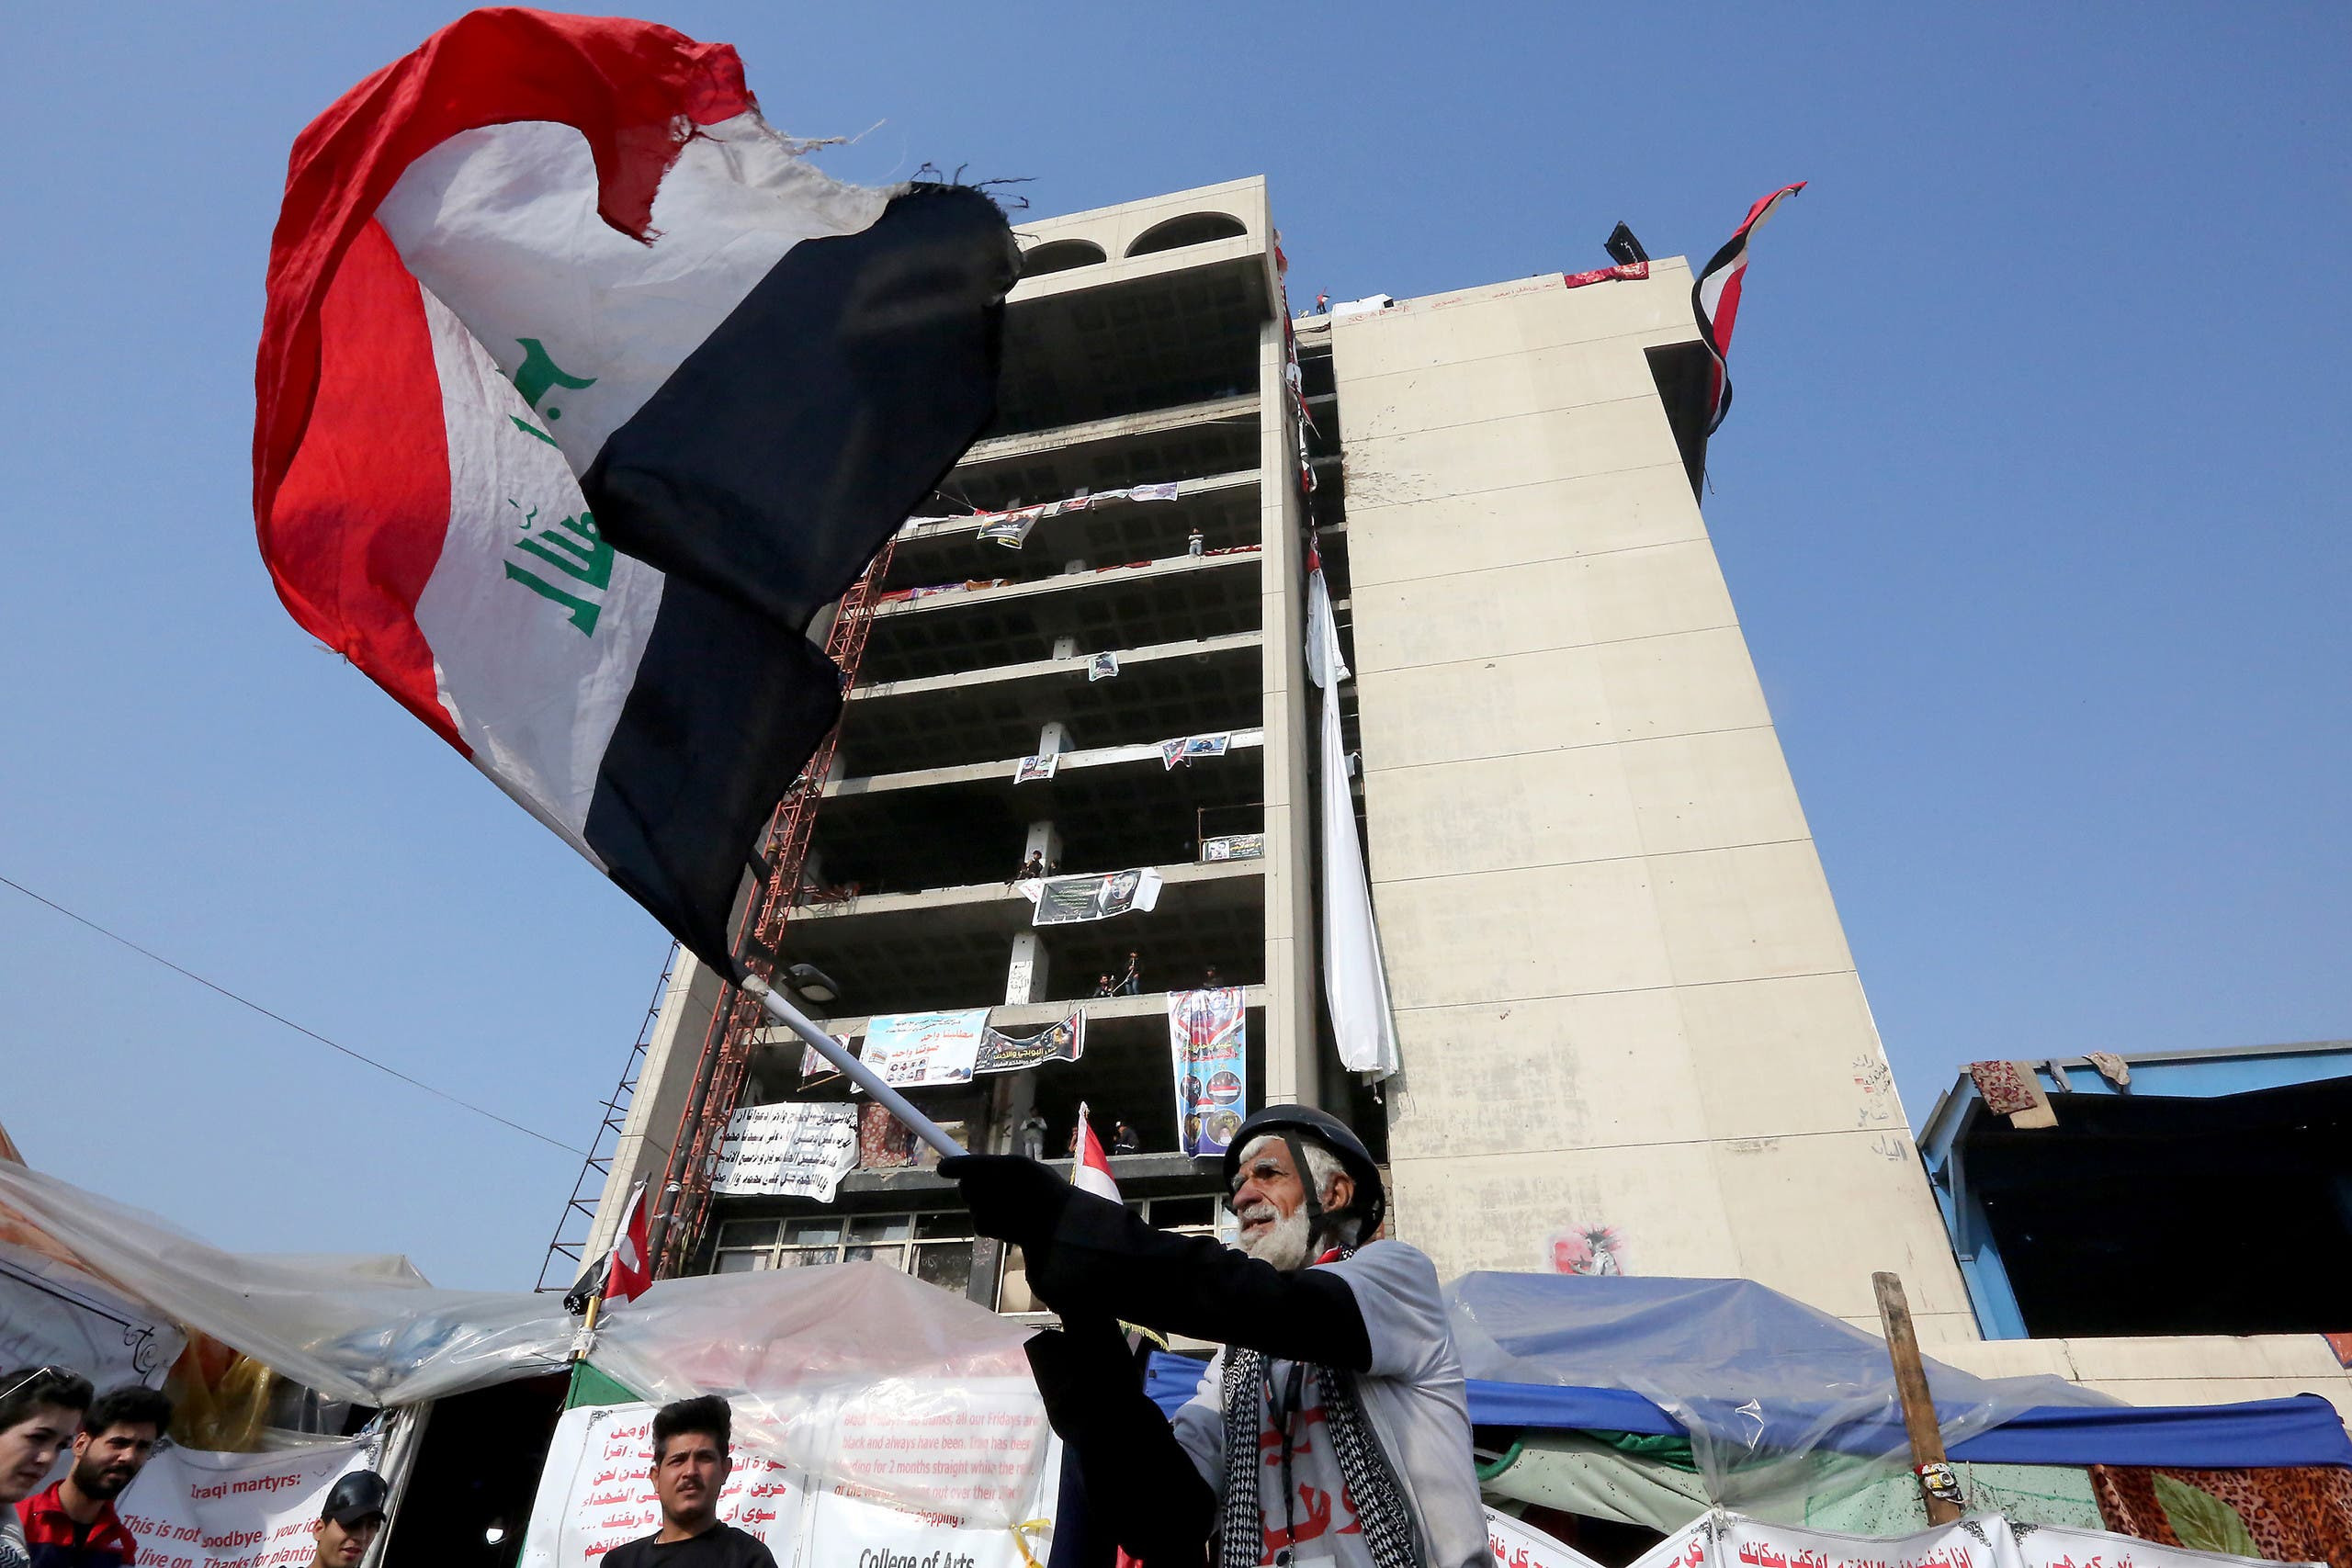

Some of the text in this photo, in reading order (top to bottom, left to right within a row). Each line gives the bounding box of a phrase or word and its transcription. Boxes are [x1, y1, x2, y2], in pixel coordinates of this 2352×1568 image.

[956, 1412, 967, 1426] all
[969, 1416, 985, 1426] our
[987, 1412, 1022, 1429] Fridays
[866, 1437, 883, 1449] and
[884, 1436, 915, 1452] always
[991, 1436, 1008, 1449] has
[873, 1459, 888, 1473] for
[888, 1460, 895, 1473] 2
[897, 1459, 931, 1474] months
[932, 1460, 969, 1477] straight
[999, 1461, 1014, 1474] the
[191, 1473, 302, 1500] Iraqi martyrs:
[123, 1514, 154, 1535] This
[156, 1519, 168, 1539] is
[172, 1525, 202, 1543] not
[272, 1521, 303, 1542] your
[137, 1548, 168, 1568] live
[251, 1552, 271, 1568] for
[269, 1544, 318, 1567] plantin
[859, 1548, 975, 1568] College of Arts
